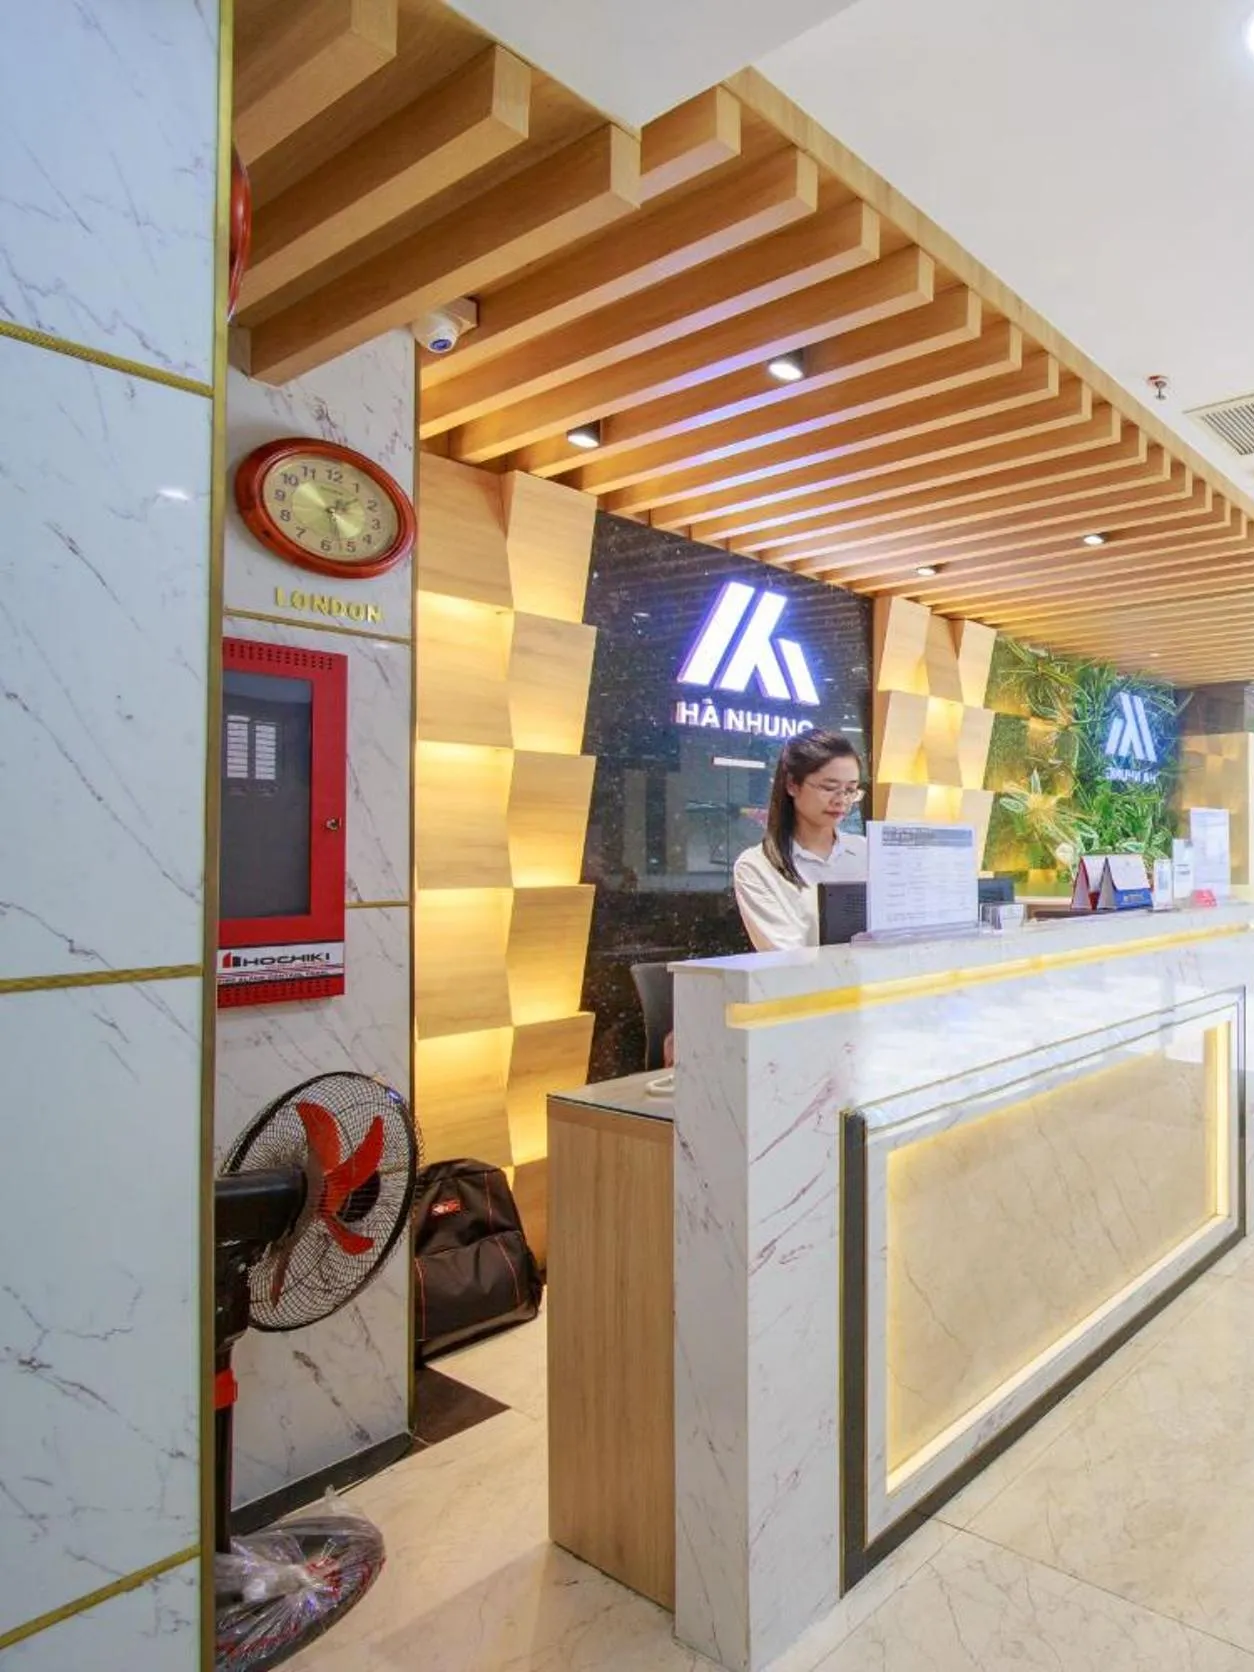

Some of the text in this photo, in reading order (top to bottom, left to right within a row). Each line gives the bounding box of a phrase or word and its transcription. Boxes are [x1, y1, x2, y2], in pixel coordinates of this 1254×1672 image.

[280, 472, 299, 486] 10
[301, 466, 317, 480] 11
[326, 469, 344, 484] 12
[353, 483, 360, 493] 1
[274, 489, 286, 501] 9
[367, 500, 379, 512] 2
[280, 510, 291, 522] 8
[372, 518, 381, 530] 3
[296, 526, 307, 538] 7
[320, 539, 331, 551] 6
[346, 541, 356, 552] 5
[274, 586, 382, 624] LONDON
[676, 698, 721, 728] HÀ
[242, 952, 330, 967] HOCHIKI
